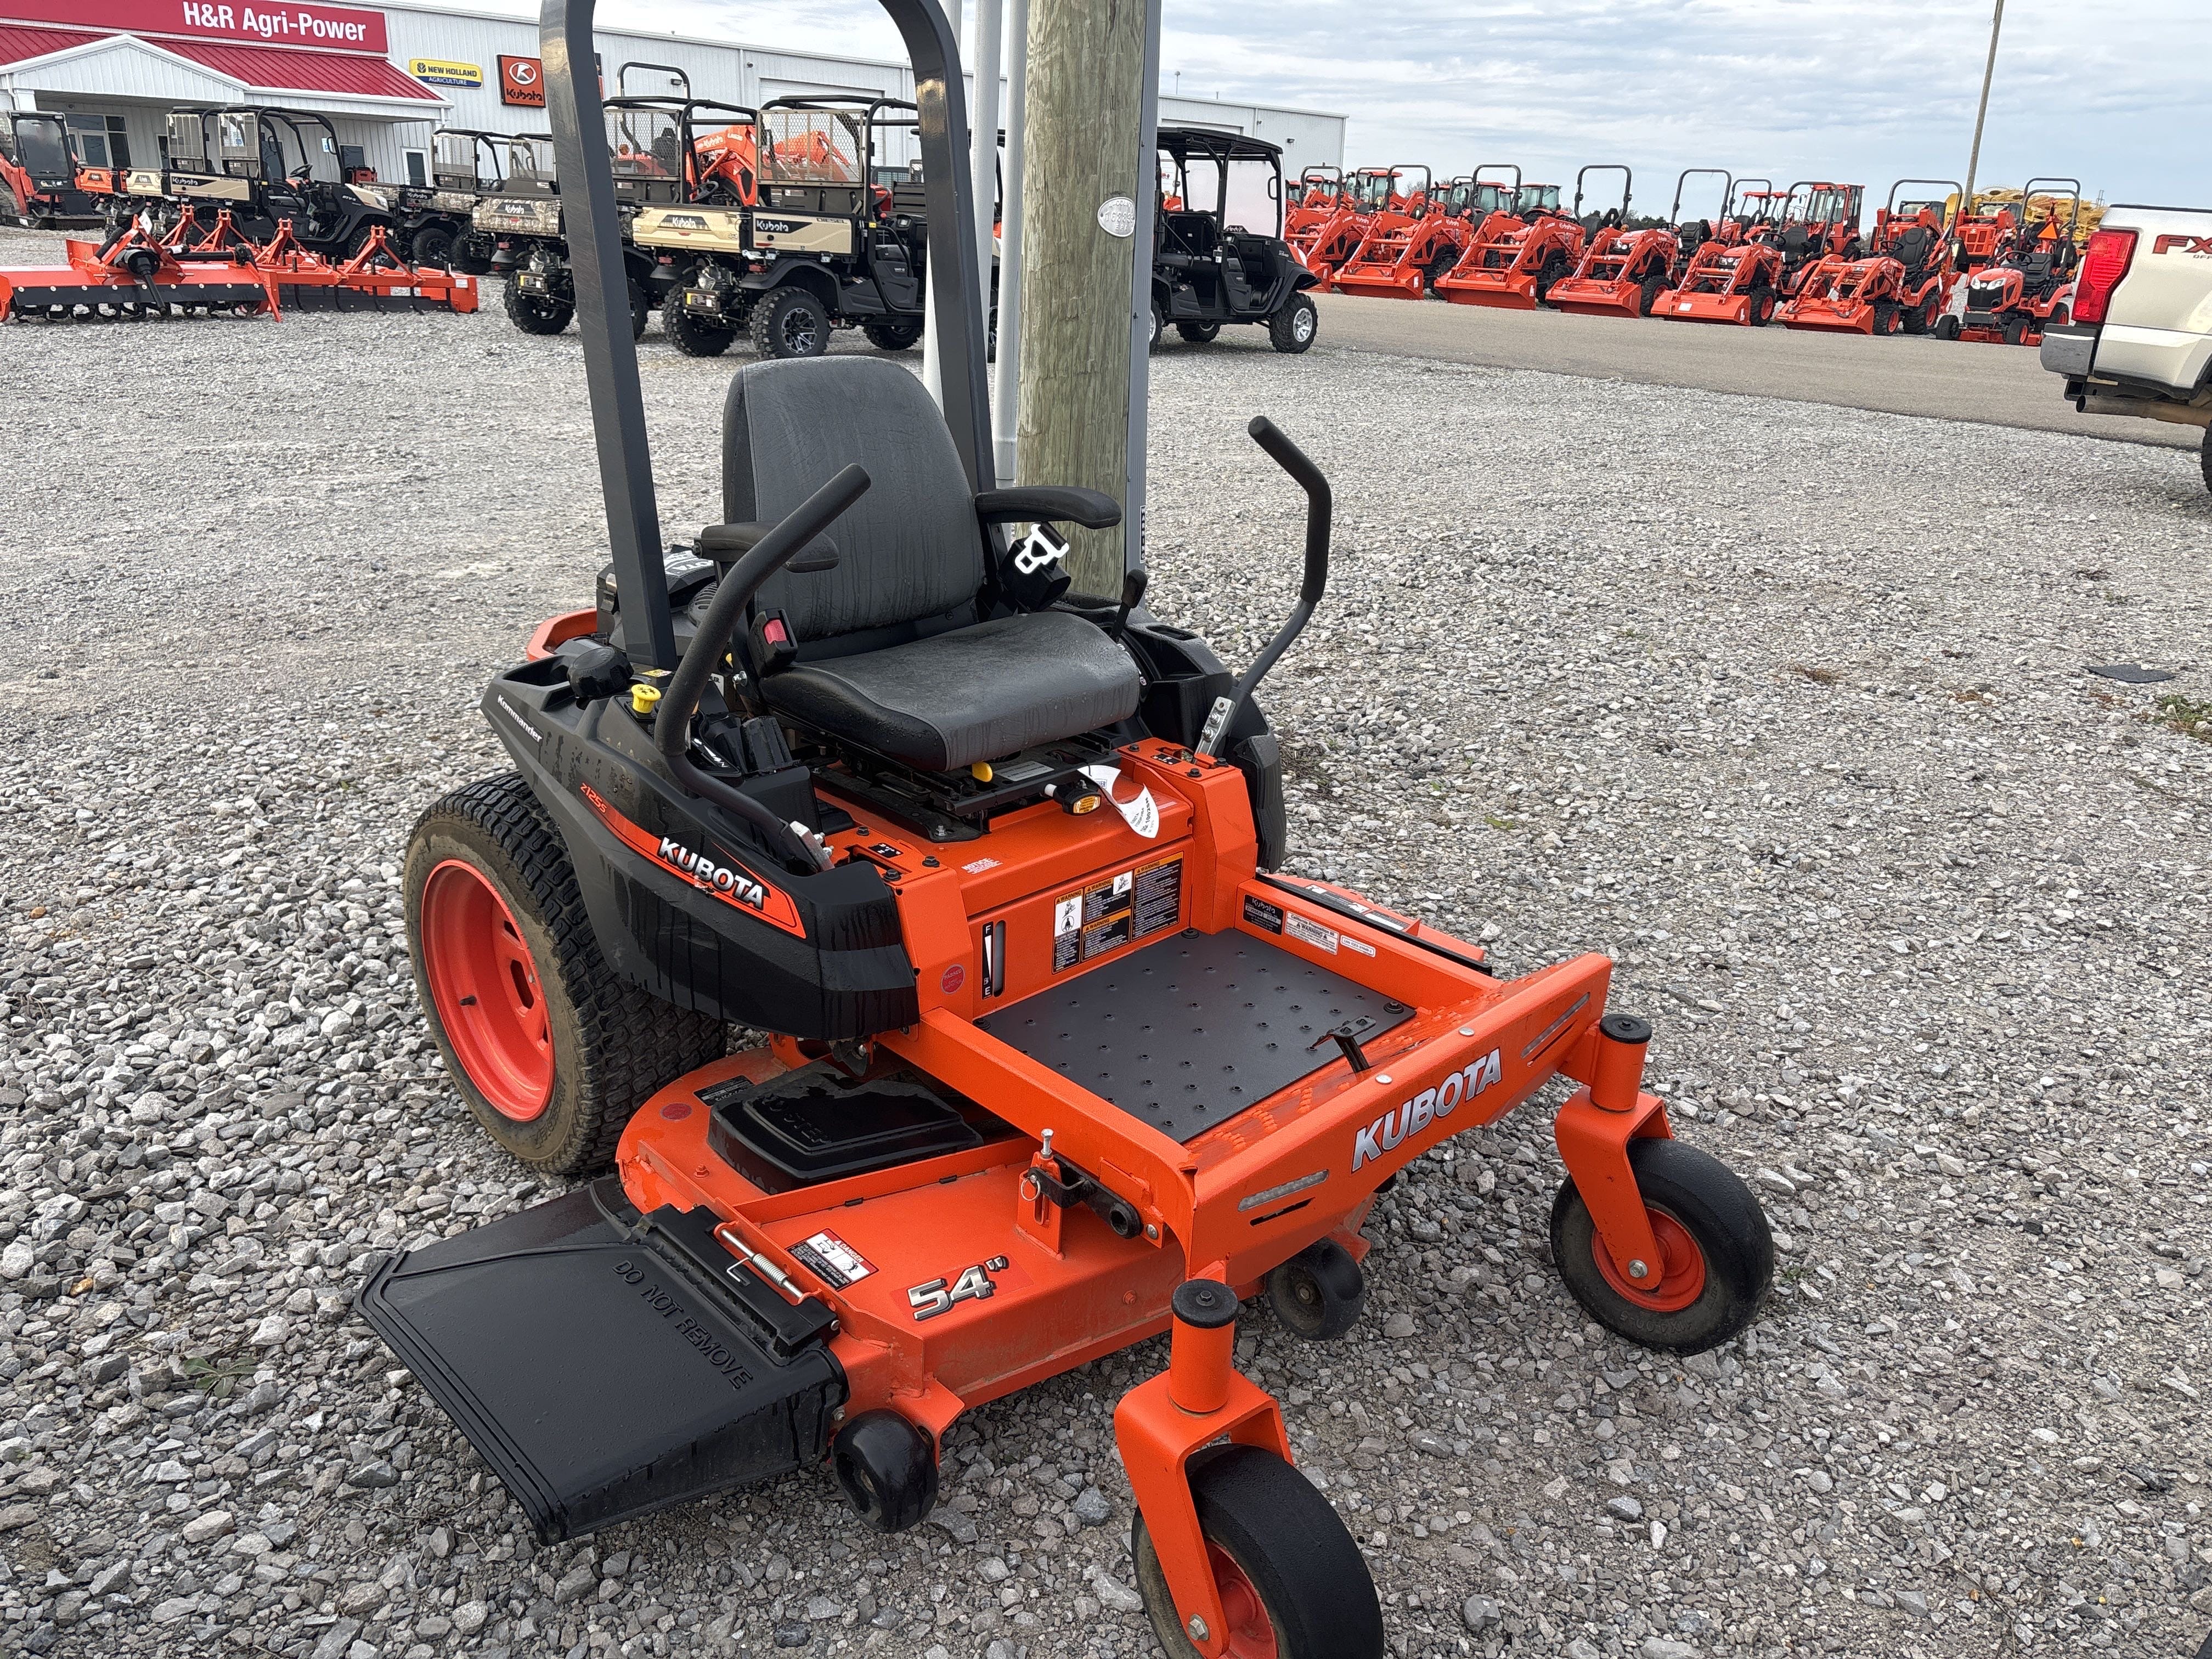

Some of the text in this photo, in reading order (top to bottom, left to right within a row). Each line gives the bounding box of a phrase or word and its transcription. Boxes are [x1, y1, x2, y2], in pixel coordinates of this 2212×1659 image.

[183, 1, 366, 41] H&R Agri-Power
[428, 66, 477, 78] NEW HOLLAND
[428, 76, 467, 86] AGRICULTURE
[506, 87, 543, 102] Kubota
[172, 177, 198, 185] Kubota
[672, 217, 696, 229] Kubota
[757, 219, 789, 232] Kubota
[2152, 234, 2212, 254] FX
[498, 694, 543, 743] Kommander
[580, 782, 608, 814] Z125S
[659, 837, 766, 910] KUBOTA
[1141, 862, 1160, 871] WARNING
[1091, 879, 1111, 890] WARNING
[1060, 890, 1082, 901] WARNING
[1252, 898, 1276, 914] Kubota
[985, 924, 991, 934] F
[1089, 918, 1110, 929] WARNING
[1291, 914, 1308, 925] California
[1308, 921, 1329, 934] Proposition
[1301, 923, 1323, 938] WARNING
[985, 986, 991, 996] E
[1351, 1047, 1502, 1172] KUBOTA
[839, 1243, 865, 1263] DANGER
[612, 1259, 754, 1391] DO NOT REMOVE
